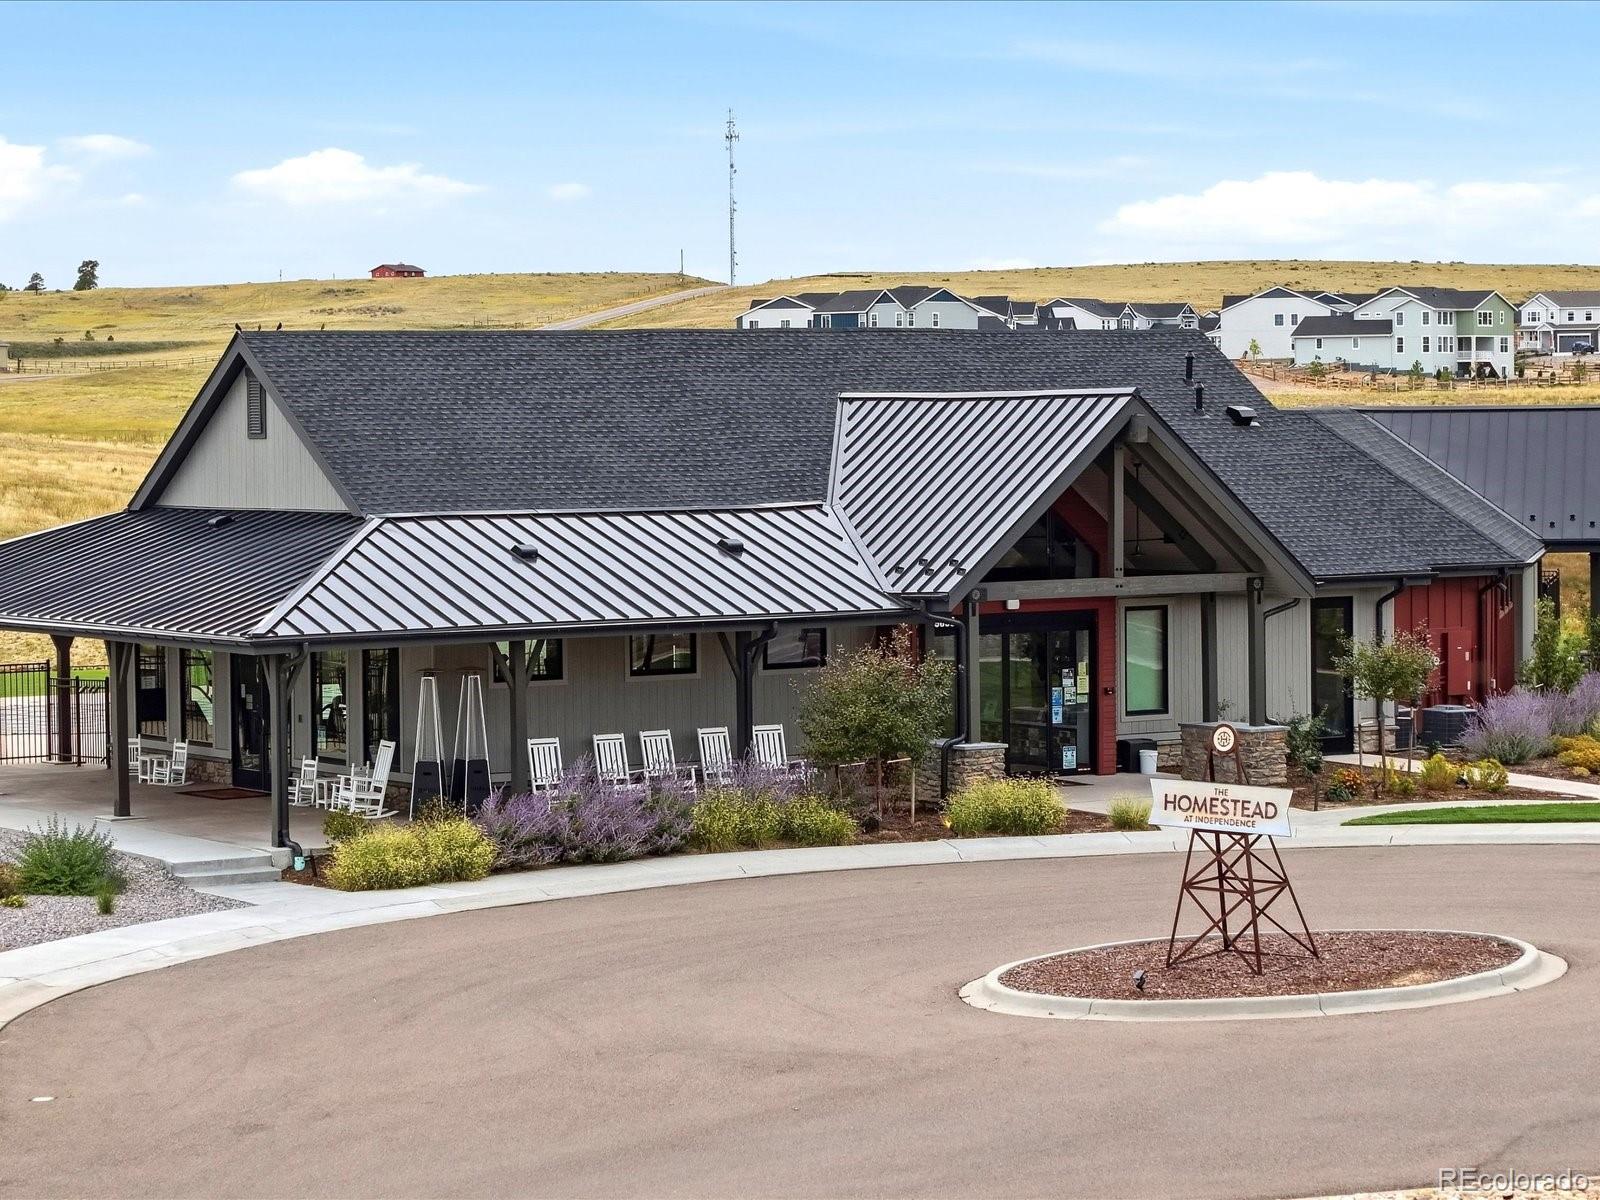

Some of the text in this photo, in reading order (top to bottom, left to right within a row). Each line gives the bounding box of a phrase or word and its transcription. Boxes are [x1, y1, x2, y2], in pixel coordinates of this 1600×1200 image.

[1214, 788, 1229, 797] THE
[1164, 793, 1278, 820] HOMESTEAD
[1184, 815, 1256, 829] AT INDEPENDENCE
